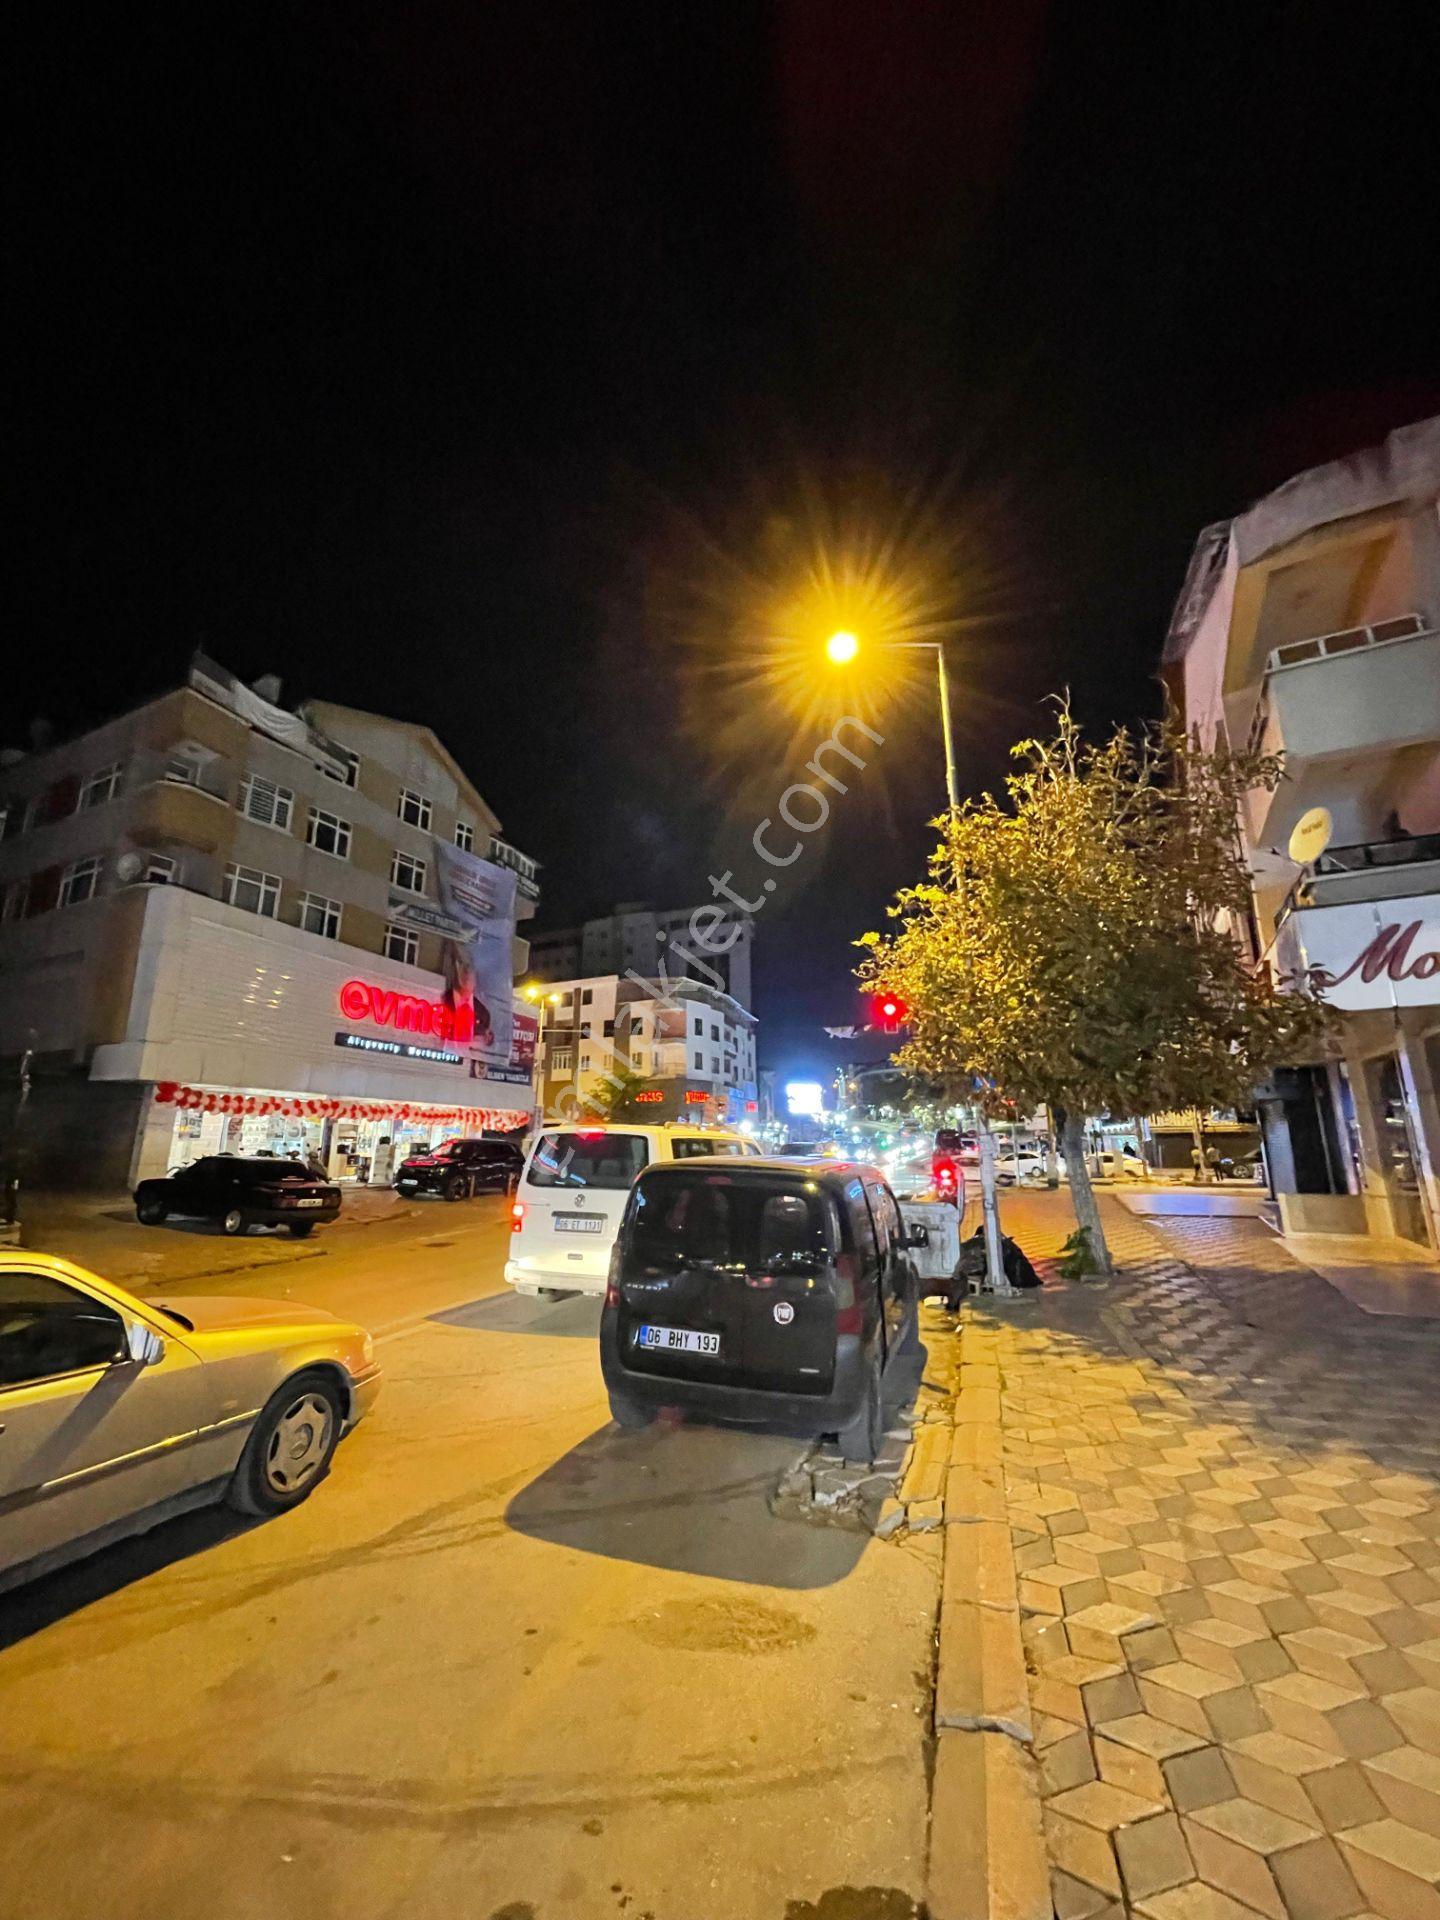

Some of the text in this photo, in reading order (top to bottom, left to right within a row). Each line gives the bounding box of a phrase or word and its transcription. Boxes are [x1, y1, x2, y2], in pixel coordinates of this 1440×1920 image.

[647, 1327, 718, 1352] 06 BHY 193
